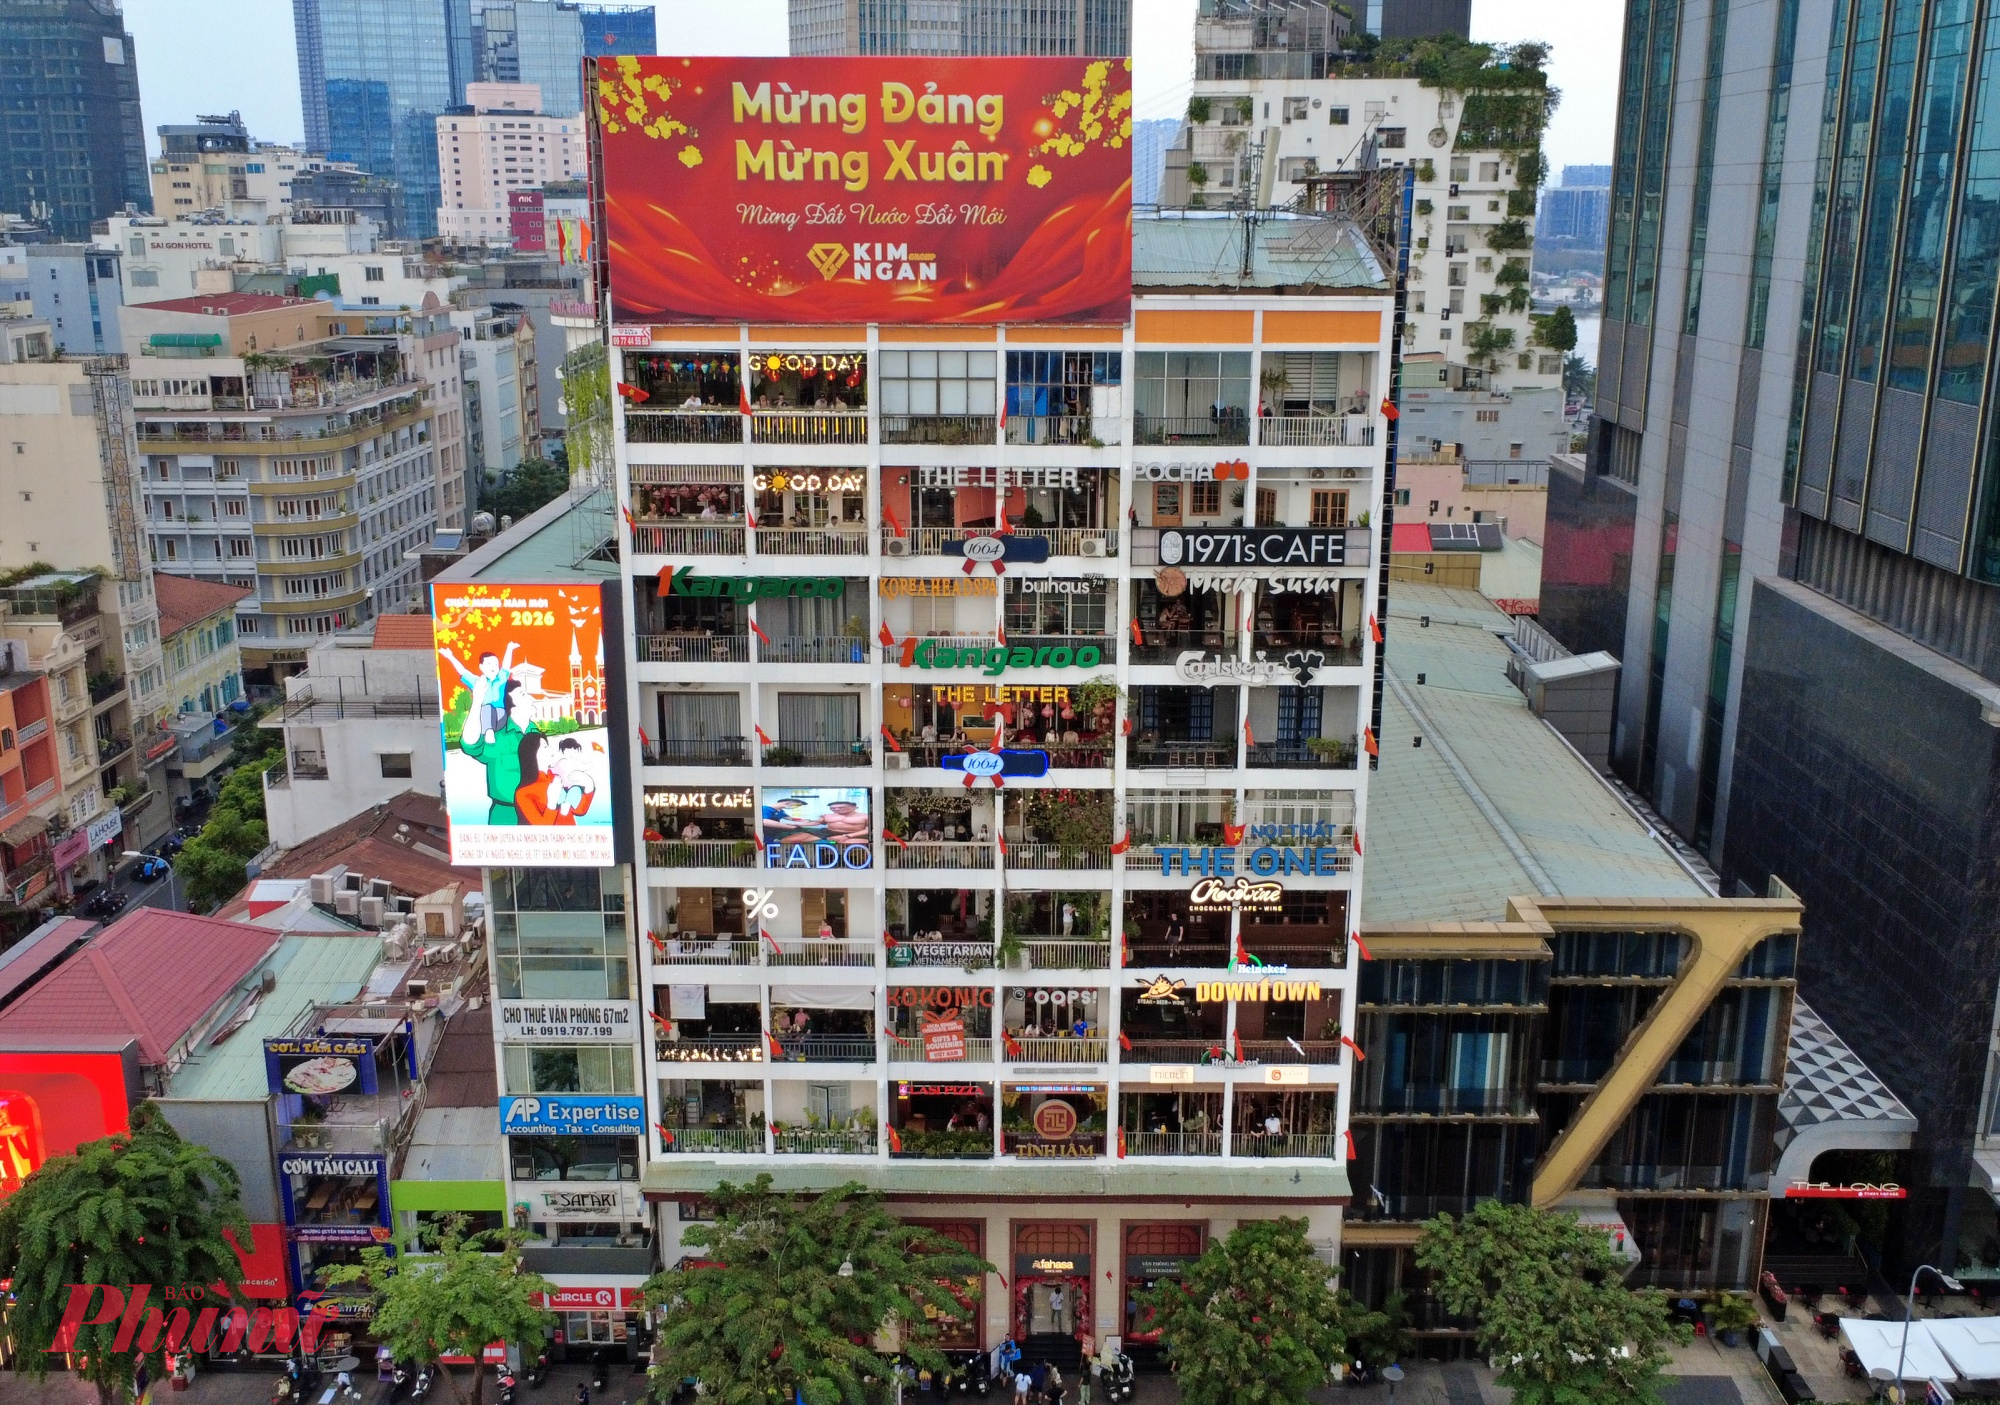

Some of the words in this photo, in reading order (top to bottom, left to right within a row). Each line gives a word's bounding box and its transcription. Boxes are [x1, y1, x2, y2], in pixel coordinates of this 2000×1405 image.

[731, 81, 867, 134] Mừng
[880, 81, 1004, 135] Đảng
[735, 139, 870, 192] Mừng
[882, 139, 1004, 181] Xuân
[736, 203, 801, 232] Mừng
[804, 202, 847, 225] Đất
[849, 202, 911, 225] Nước
[914, 202, 957, 225] Đổi
[959, 202, 1007, 225] Mới
[853, 242, 908, 261] KIM
[853, 262, 937, 281] NGAN
[822, 354, 863, 372] DAY
[919, 466, 969, 487] THE
[980, 466, 1078, 488] LETTER
[1132, 462, 1214, 482] POCHA
[827, 474, 864, 491] DAY
[968, 543, 1000, 556] 1664
[1185, 534, 1256, 563] 1971's
[1260, 534, 1344, 563] CAFE
[656, 565, 845, 605] Kangaroo
[879, 577, 927, 600] KOREA
[1264, 569, 1340, 595] Sushi
[511, 610, 555, 626] 2026
[899, 637, 1101, 676] Kangaroo
[1175, 650, 1280, 684] Carlsberg
[931, 686, 976, 703] THE
[985, 686, 1069, 703] LETTER
[967, 757, 1001, 770] 1664
[644, 793, 706, 808] MERAKI
[712, 788, 753, 808] CAFÉ
[766, 843, 872, 870] FADO
[1154, 847, 1236, 876] THE
[1250, 847, 1337, 876] ONE
[894, 947, 908, 957] 21
[914, 946, 992, 956] VEGETARIAN
[1237, 964, 1287, 974] Heineken
[1034, 990, 1097, 1005] OOPS!
[1196, 976, 1321, 1002] DOWNTOWN
[503, 1007, 522, 1024] CHO
[523, 1004, 547, 1024] THUÊ
[549, 1004, 568, 1024] VĂN
[570, 1003, 601, 1024] PHÒNG
[603, 1007, 629, 1024] 67m2
[521, 1026, 538, 1036] LH:
[540, 1026, 613, 1036] 0919.797.199
[334, 1043, 367, 1054] CALI
[926, 1040, 964, 1050] SOUVENIRS
[946, 1086, 985, 1095] PIZZA
[548, 1103, 640, 1123] Expertise
[505, 1124, 556, 1135] Accounting
[565, 1124, 583, 1133] Tax
[592, 1124, 641, 1135] Consulting
[344, 1160, 378, 1175] CALI
[1792, 1181, 1837, 1191] THE
[1839, 1182, 1900, 1192] LONG
[1041, 1259, 1074, 1270] fahasa
[553, 1293, 593, 1302] CIRCLE
